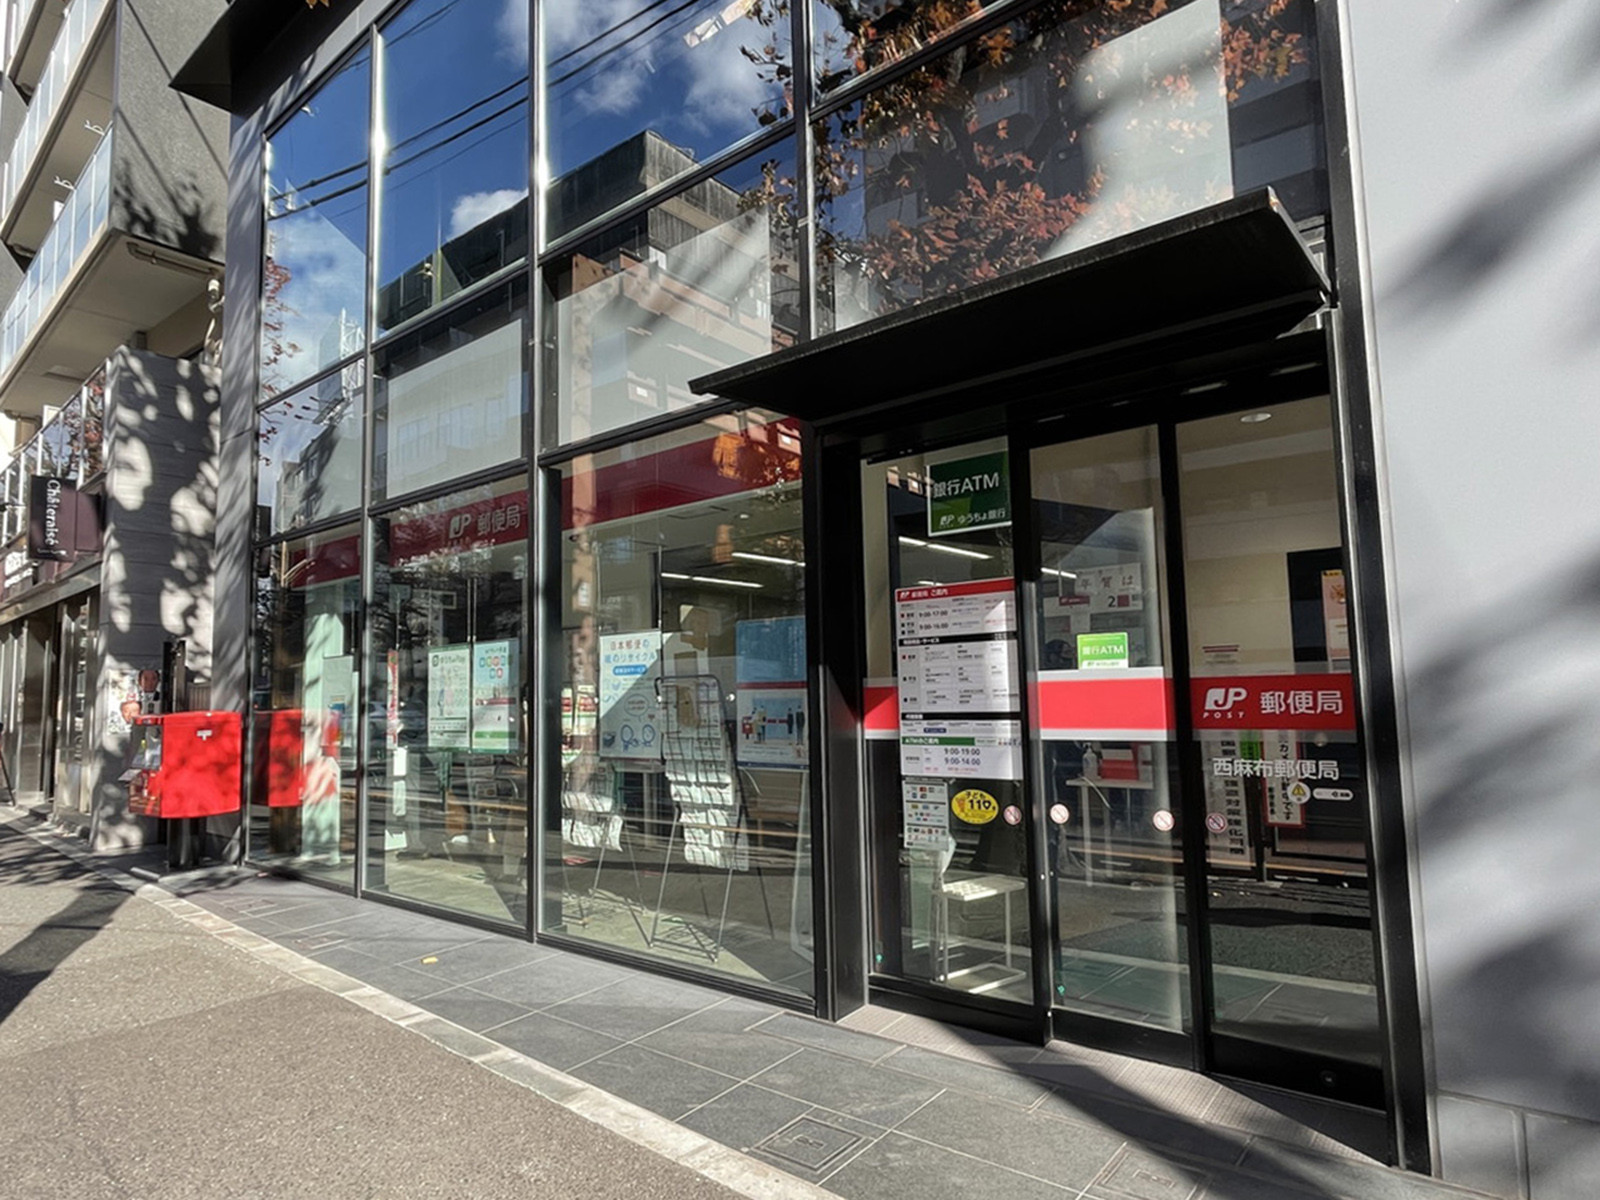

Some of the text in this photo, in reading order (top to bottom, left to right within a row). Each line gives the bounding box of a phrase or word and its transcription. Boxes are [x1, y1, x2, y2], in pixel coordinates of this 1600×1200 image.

[933, 472, 1000, 499] 銀行ATM
[477, 505, 521, 536] 郵便局
[957, 508, 1006, 524] ゆうちょ銀行
[1260, 690, 1344, 715] 郵便局
[1202, 711, 1245, 719] POST
[1212, 757, 1340, 781] 西麻布郵便局
